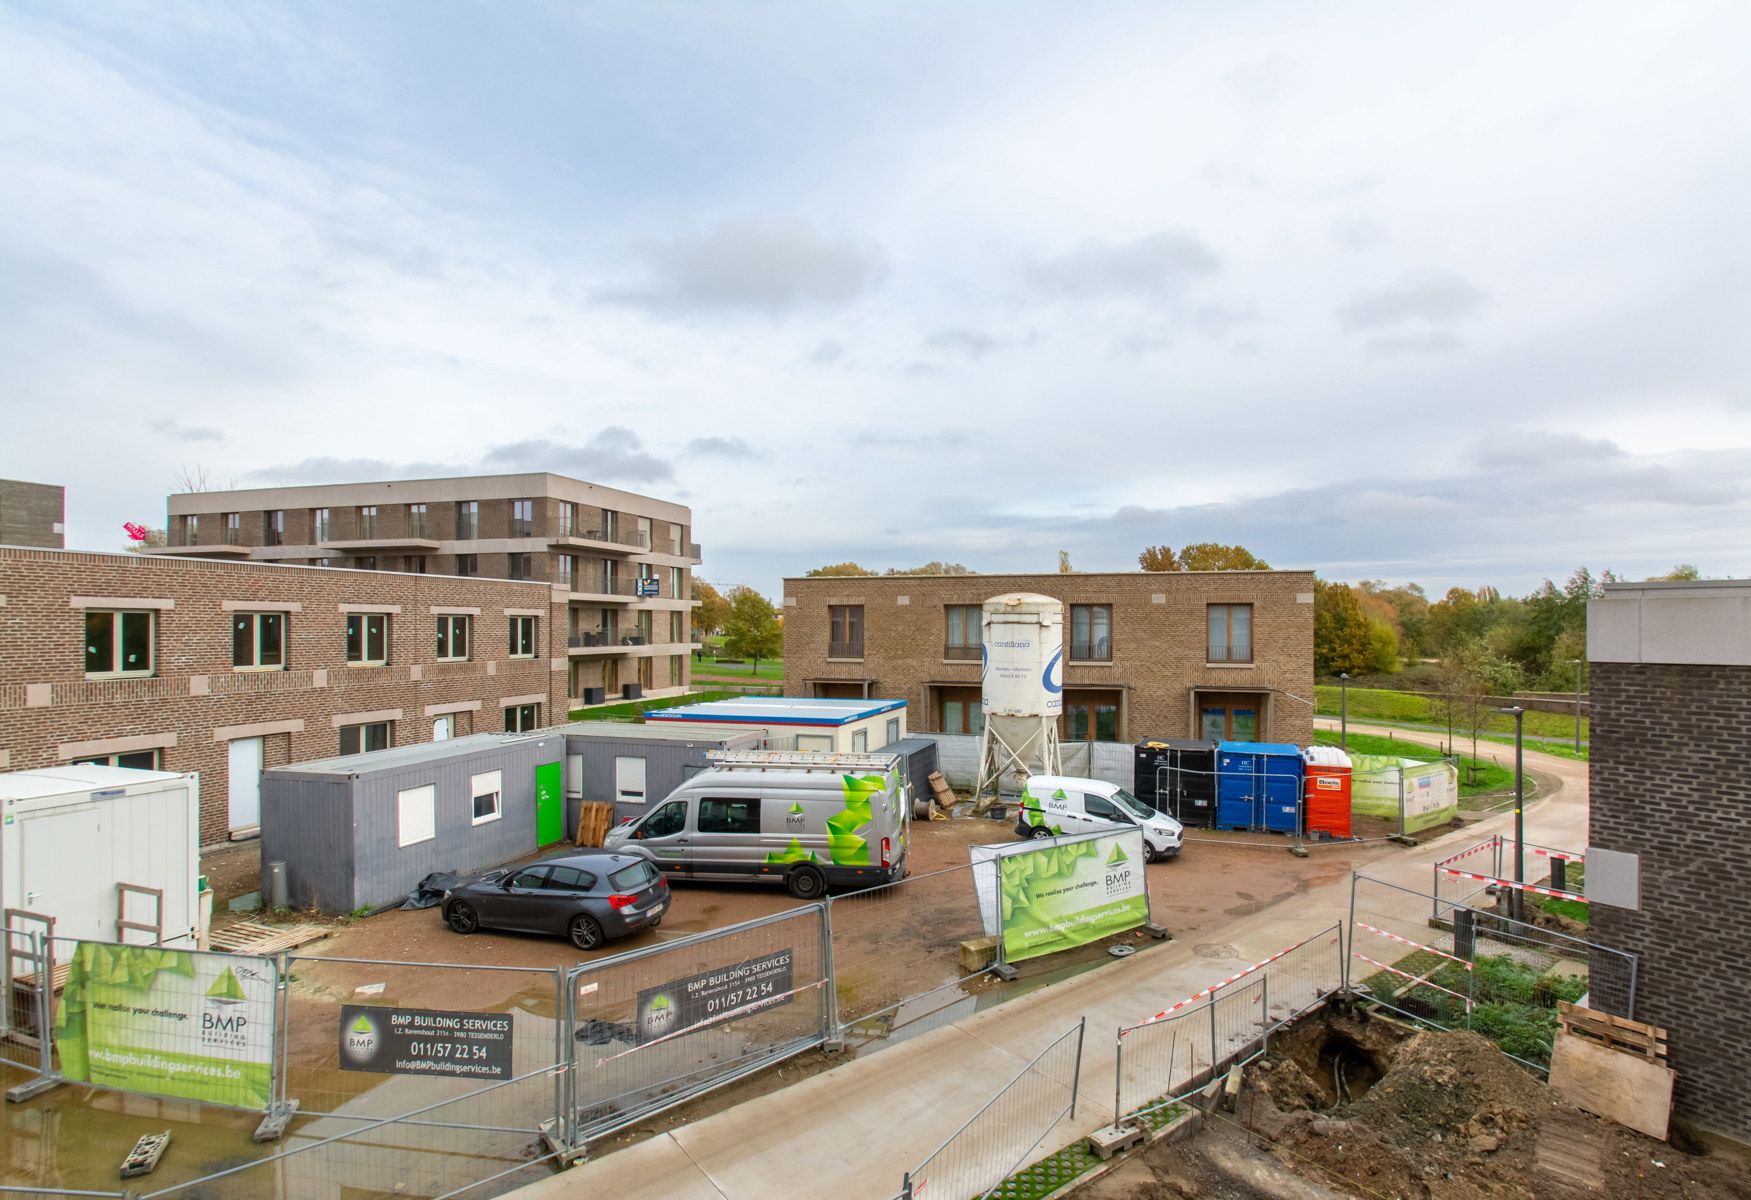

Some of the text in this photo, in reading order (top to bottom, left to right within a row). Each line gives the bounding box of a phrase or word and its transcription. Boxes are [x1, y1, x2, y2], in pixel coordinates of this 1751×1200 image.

[1049, 802, 1067, 810] BMP
[1075, 881, 1098, 889] challenge.
[1106, 871, 1130, 886] BMP
[1024, 904, 1130, 938] www.bmpbuildingservices.be
[688, 955, 790, 992] BMP BUILDING SERVICES
[707, 982, 773, 1012] 011/57 22 54
[132, 1007, 150, 1015] your
[152, 1008, 188, 1021] challenge.
[648, 1011, 672, 1024] BMP
[203, 1013, 246, 1032] BMP
[392, 1015, 508, 1031] BMP BUILDING SERVICES
[202, 1030, 245, 1040] BUILDING
[405, 1028, 435, 1036] Ravenshout
[468, 1032, 504, 1040] TESSENDERLO
[202, 1037, 245, 1046] SERVICES
[350, 1038, 372, 1047] BMP
[411, 1042, 487, 1060] 011/57 22 54
[396, 1060, 502, 1074] info@BMPbuildingservices.be
